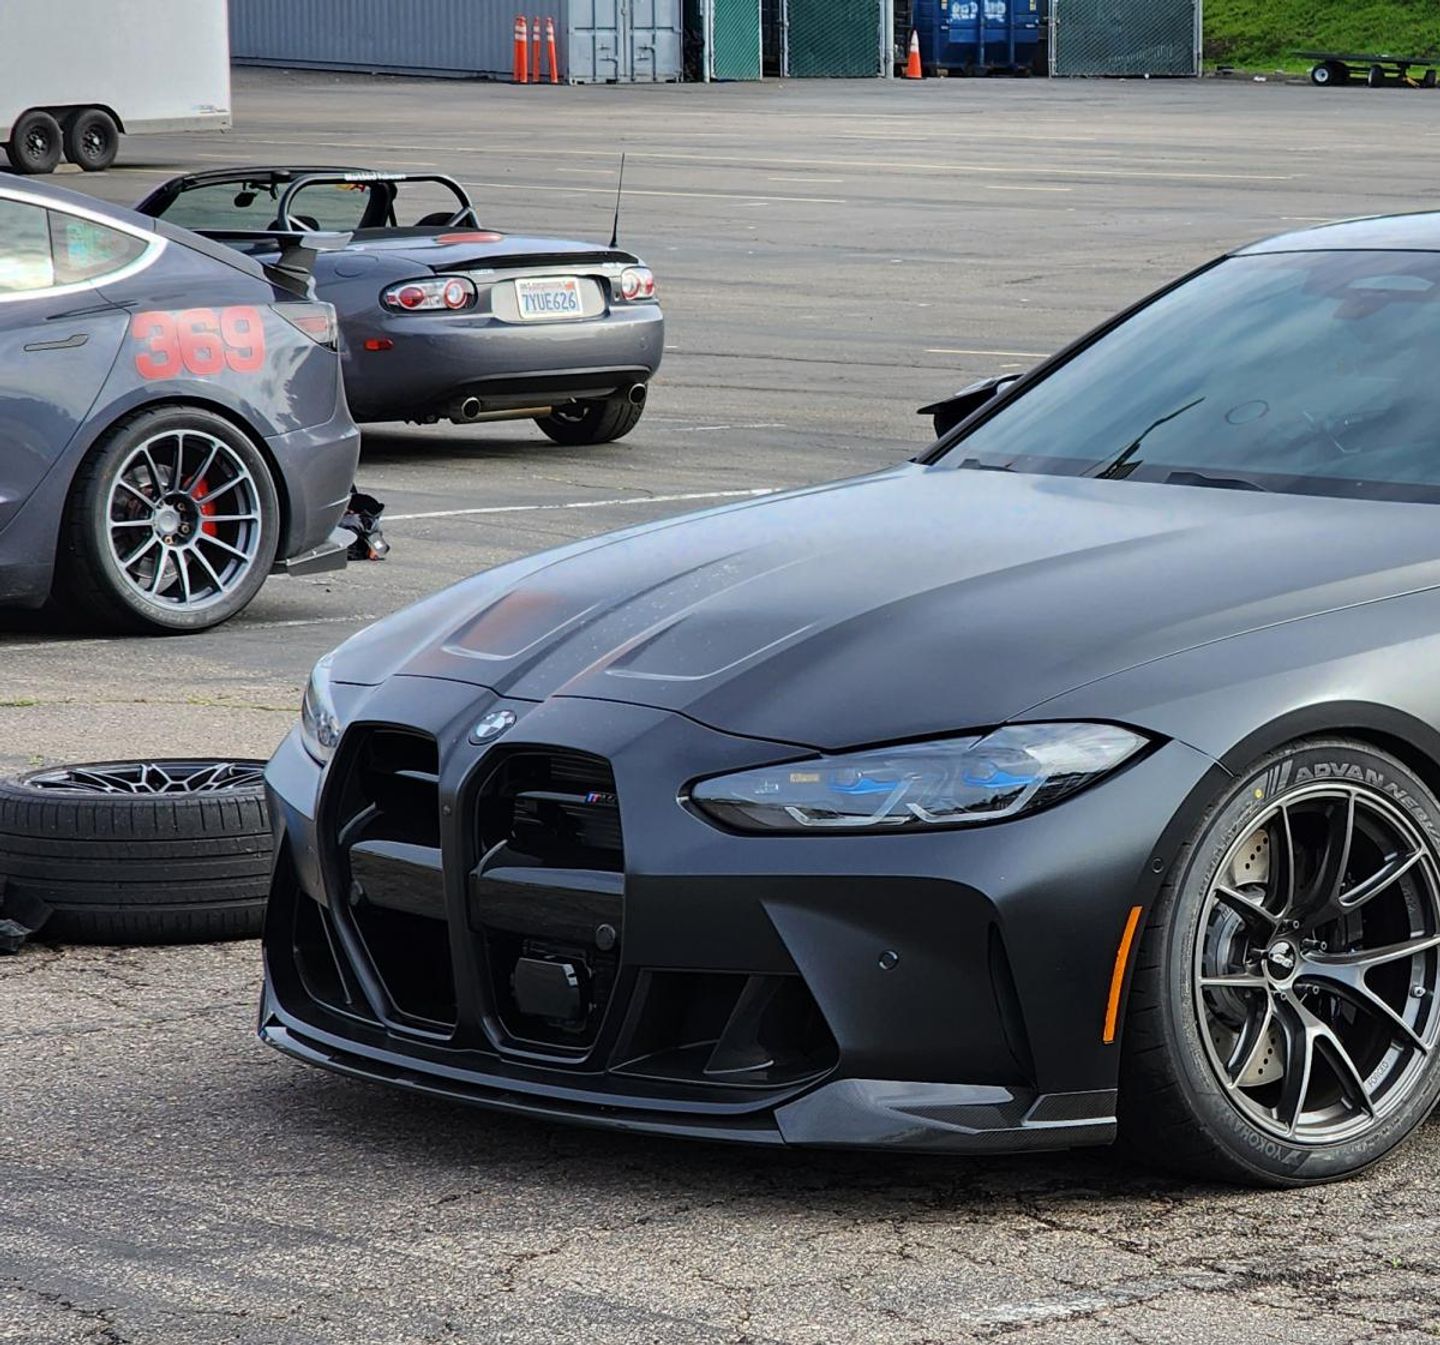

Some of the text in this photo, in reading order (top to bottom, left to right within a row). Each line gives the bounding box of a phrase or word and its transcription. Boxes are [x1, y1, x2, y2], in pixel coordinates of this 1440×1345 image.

[521, 292, 576, 311] 7YUE626
[132, 305, 266, 380] 369
[1295, 763, 1384, 787] ADVAN
[1223, 1111, 1283, 1161] YOKOHA
